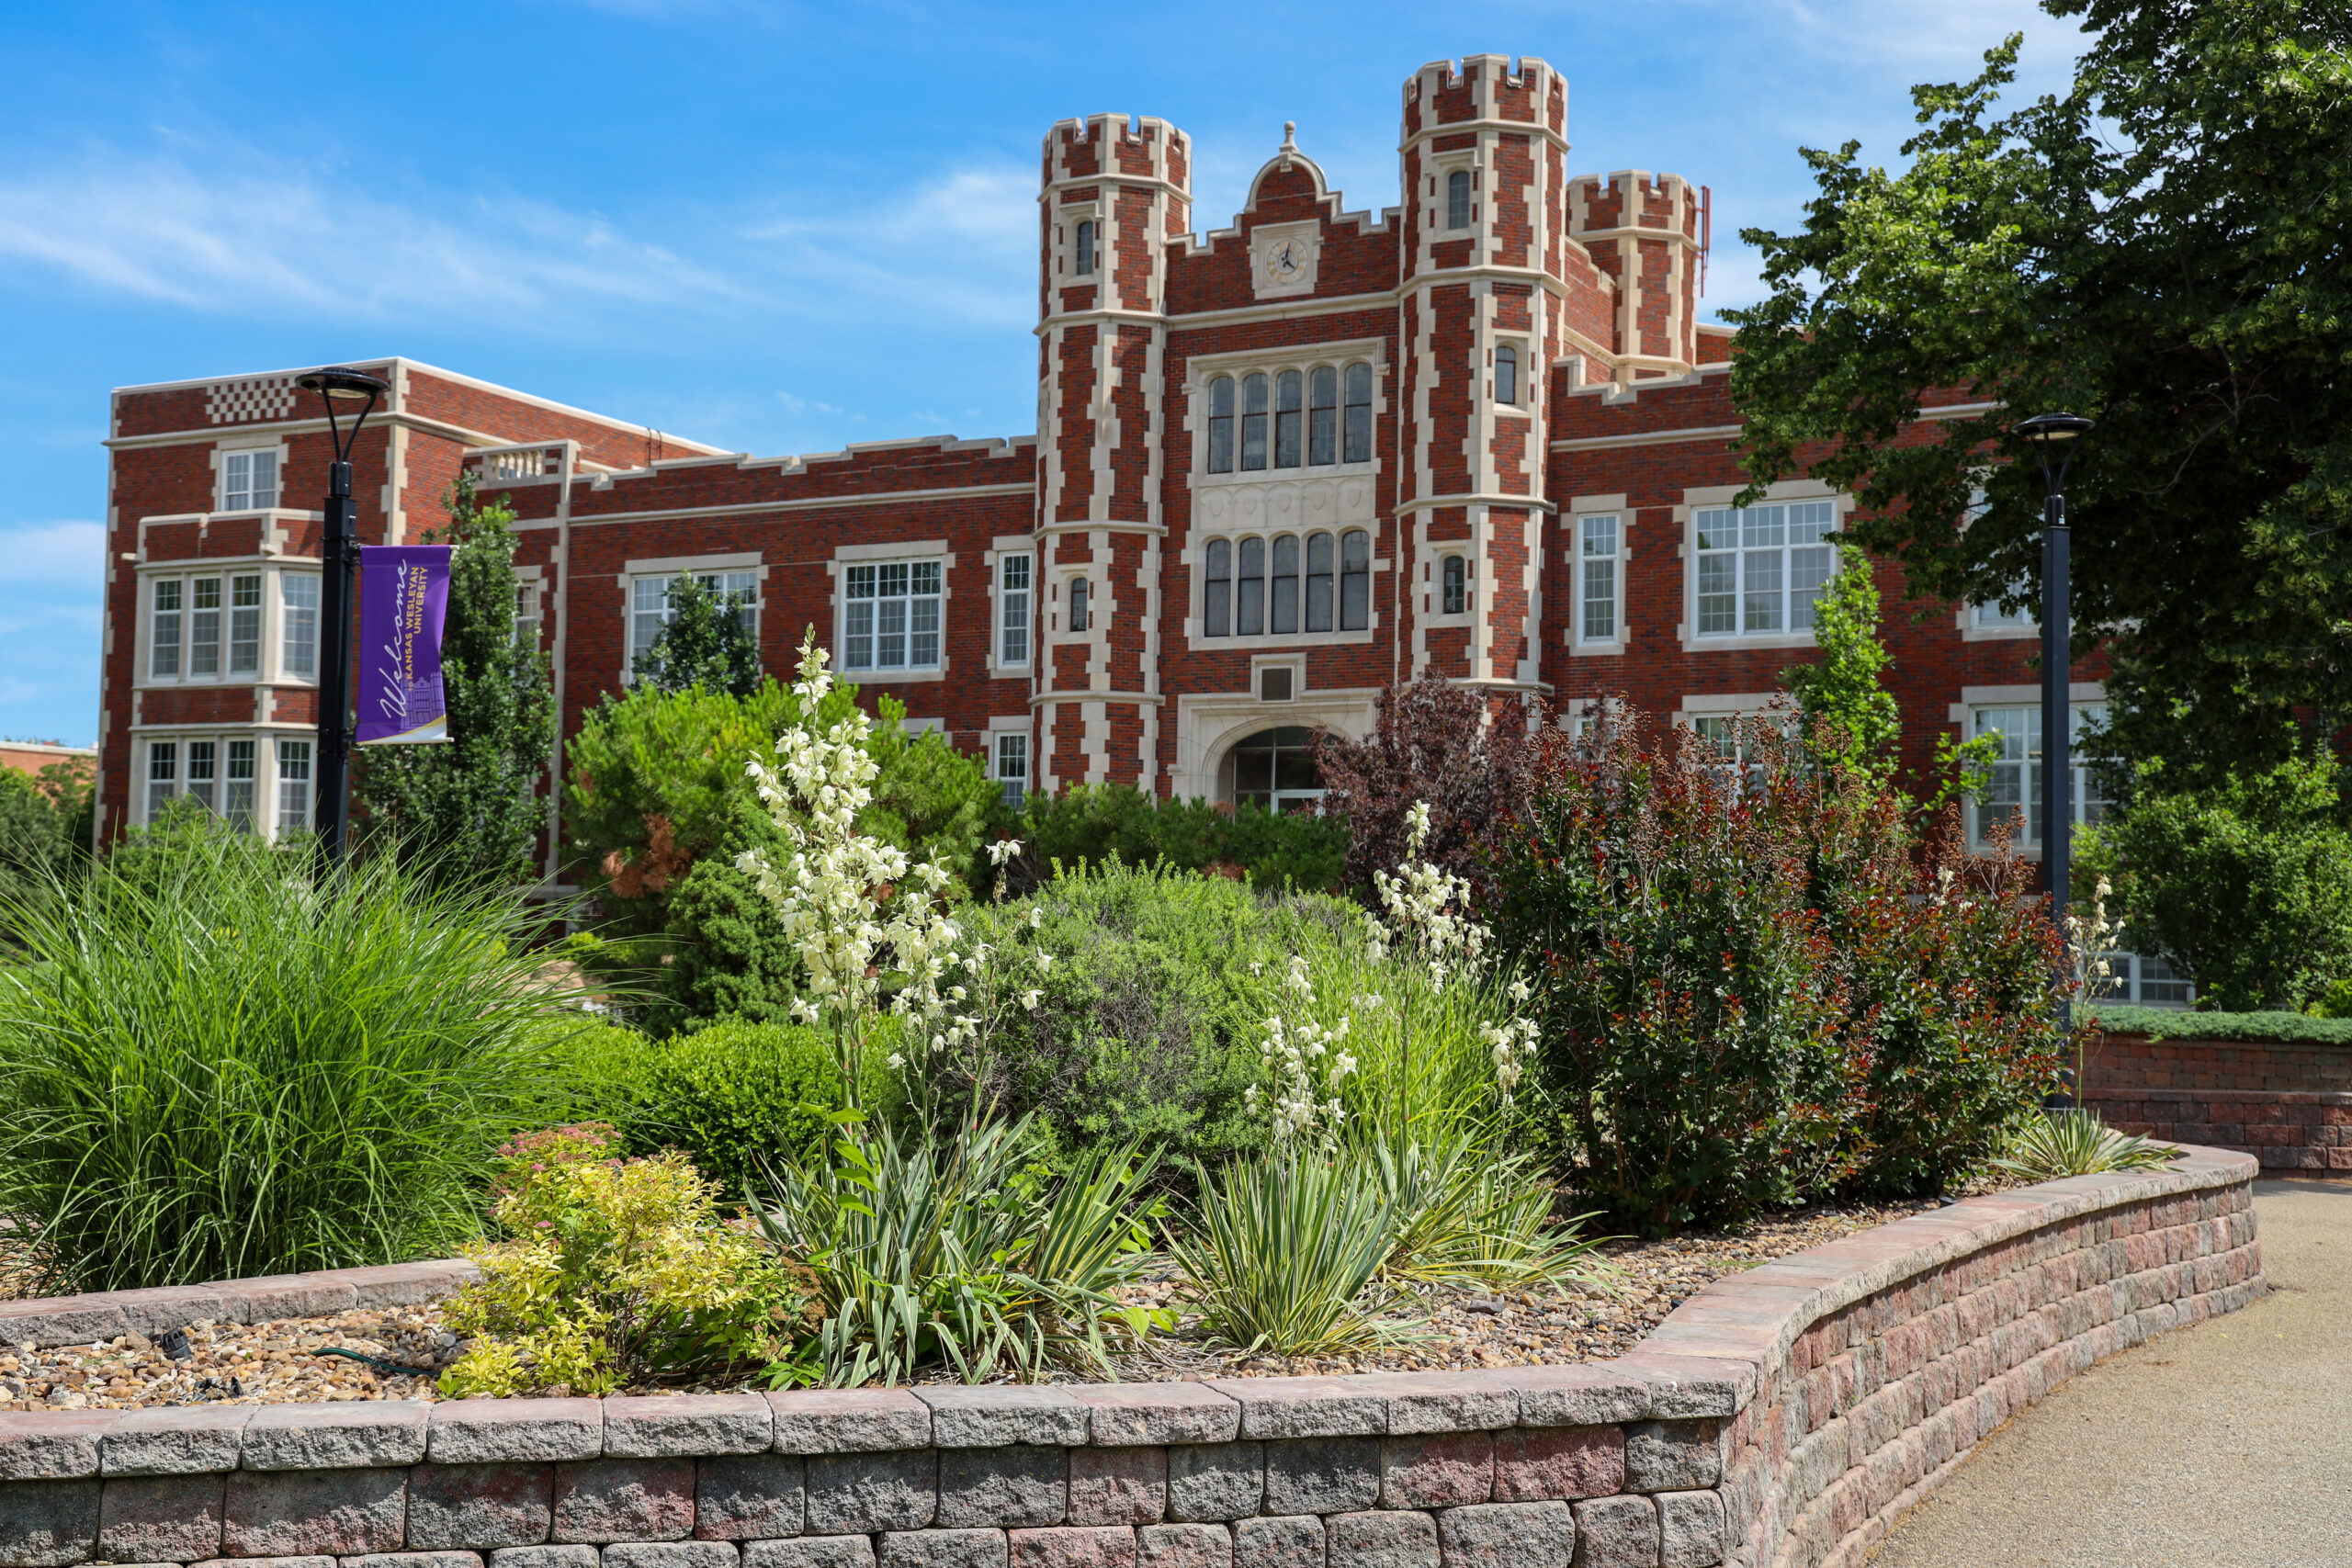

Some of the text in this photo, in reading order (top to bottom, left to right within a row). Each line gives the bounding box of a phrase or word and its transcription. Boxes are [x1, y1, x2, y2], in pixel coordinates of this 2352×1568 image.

[405, 567, 419, 630] WESLEYAN
[413, 567, 428, 635] UNIVERSITY
[379, 558, 408, 719] Welcome
[405, 633, 413, 680] KANSAS
